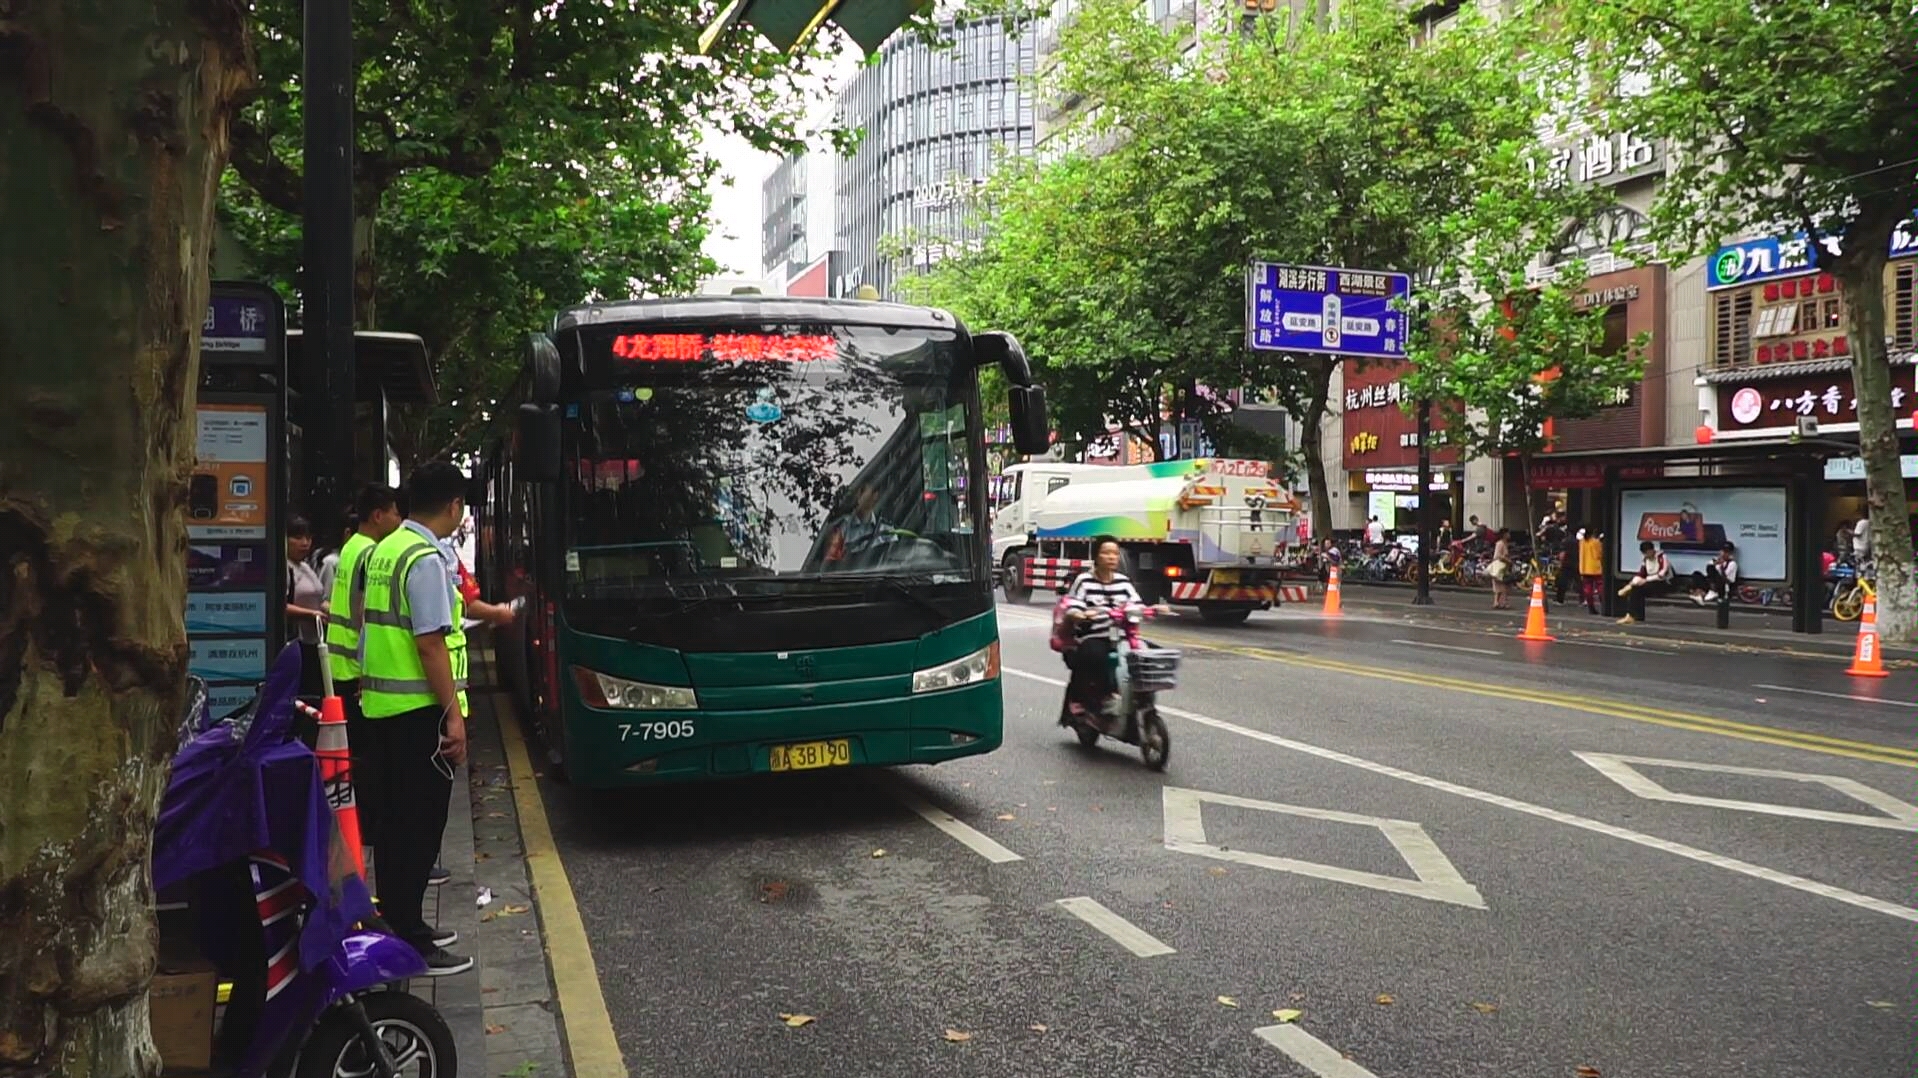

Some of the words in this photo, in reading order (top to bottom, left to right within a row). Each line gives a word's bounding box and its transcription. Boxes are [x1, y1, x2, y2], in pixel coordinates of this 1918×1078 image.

[1278, 268, 1326, 292] 湖滨步行街
[1338, 272, 1386, 290] 西湖景区
[617, 720, 695, 742] 7-7905
